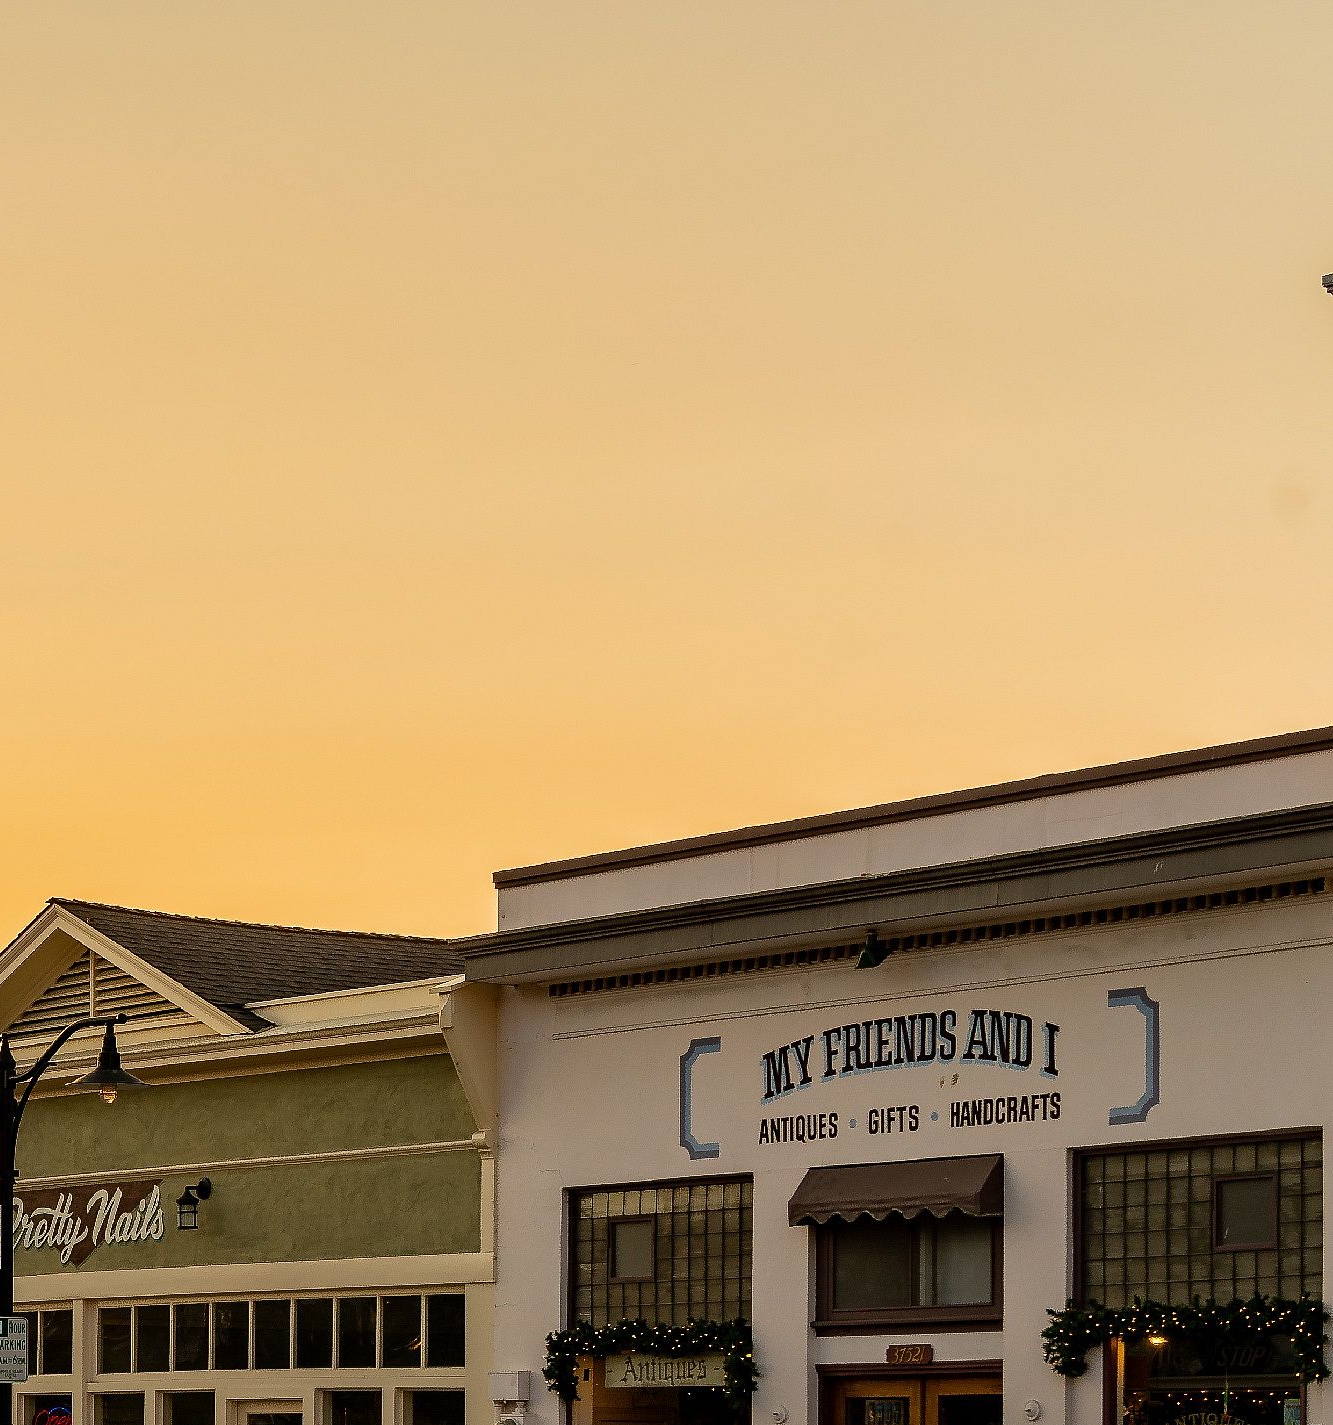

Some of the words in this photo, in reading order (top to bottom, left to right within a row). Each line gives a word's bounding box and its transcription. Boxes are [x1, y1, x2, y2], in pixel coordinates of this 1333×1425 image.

[762, 1035, 815, 1103] MY
[822, 1010, 958, 1080] FRIENDS
[962, 1009, 1033, 1070] AND
[1041, 1021, 1060, 1078] I
[759, 1113, 838, 1144] ANTIQUES
[868, 1105, 920, 1135] GIFTS
[950, 1092, 1062, 1128] HANDCRAFTS
[87, 1185, 164, 1246] Nails
[8, 1322, 26, 1334] HOUR
[621, 1355, 707, 1386] Antiques
[894, 1346, 925, 1363] 37521
